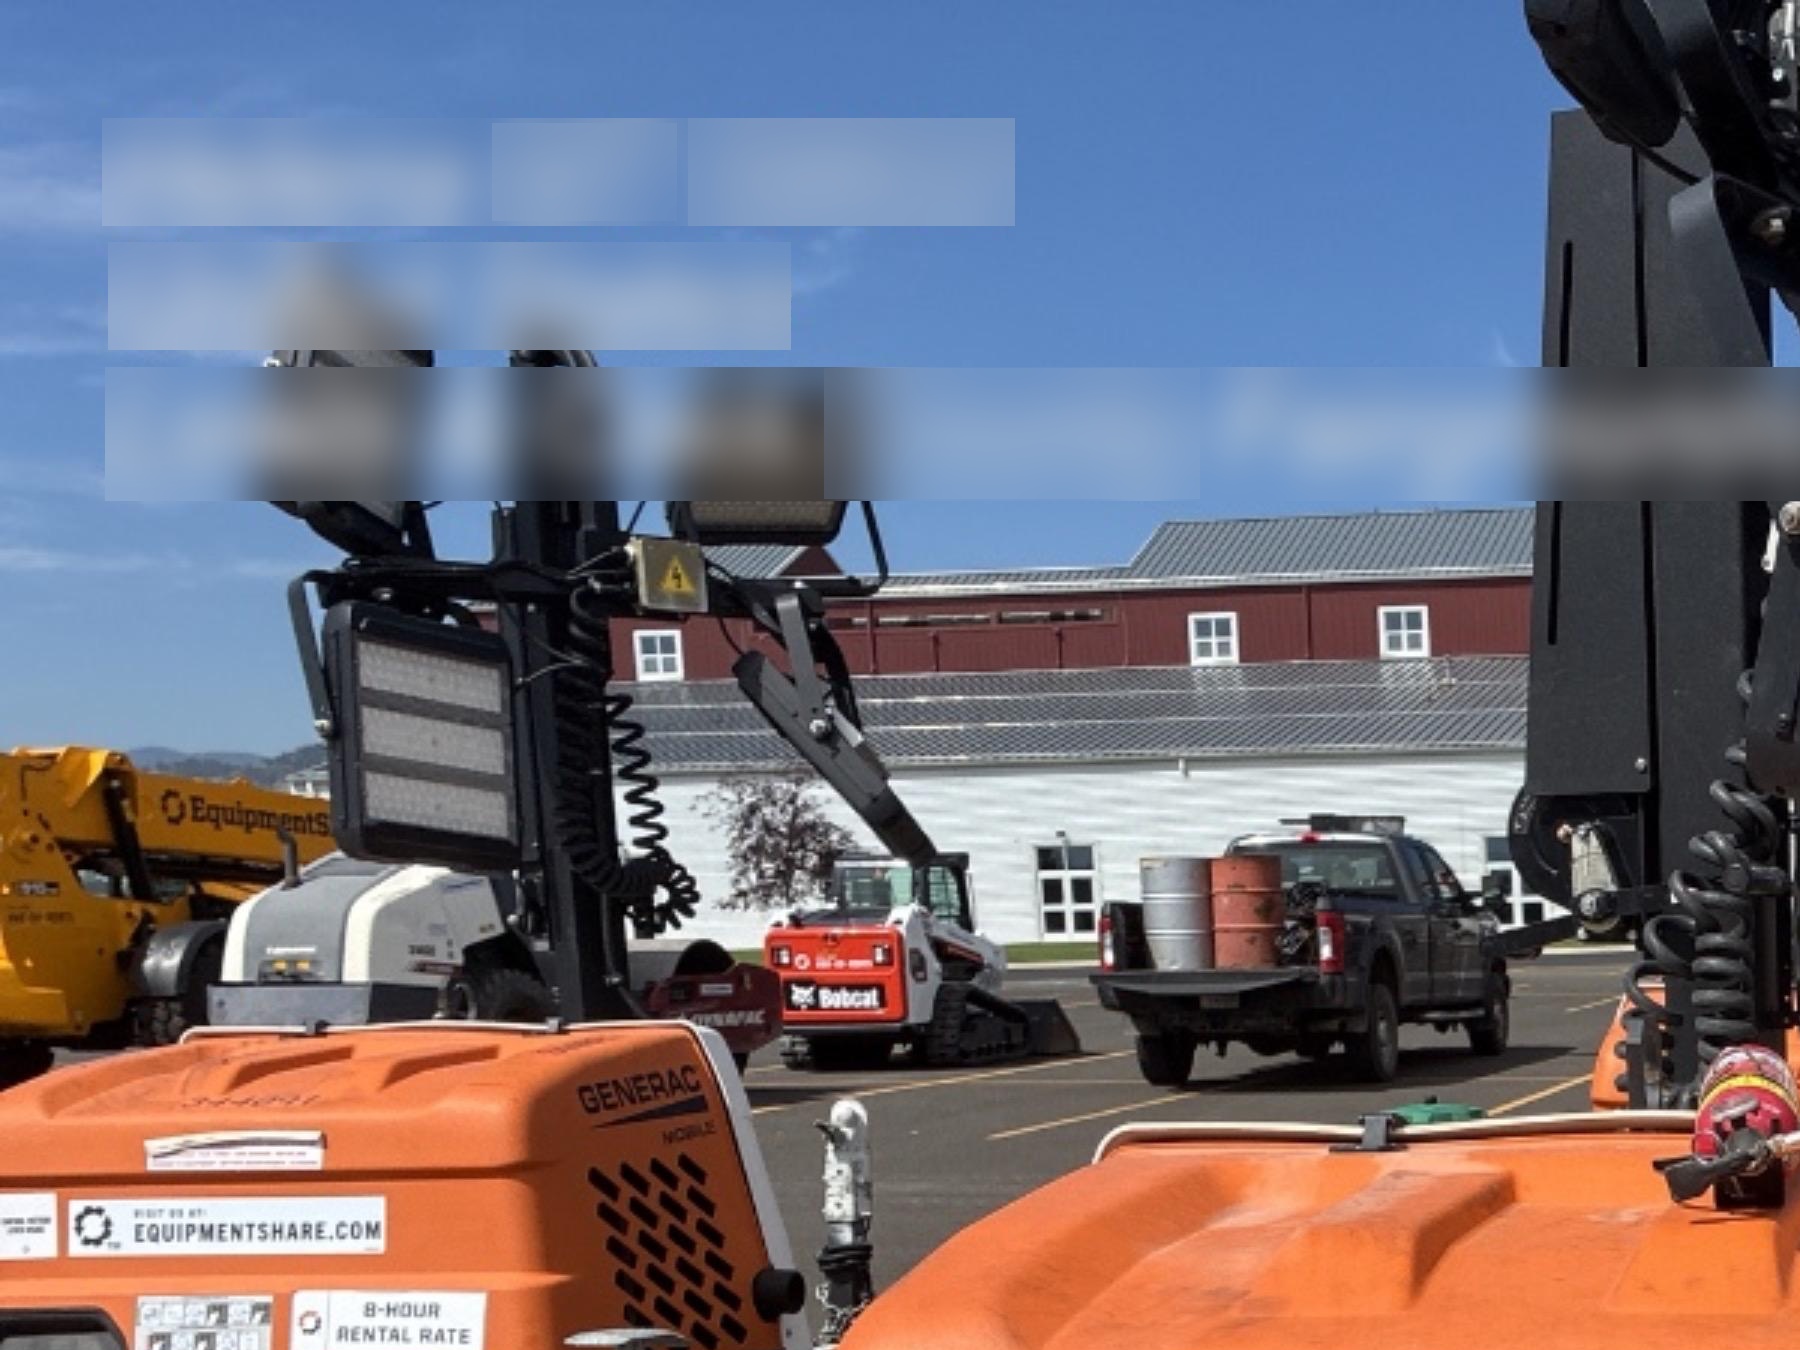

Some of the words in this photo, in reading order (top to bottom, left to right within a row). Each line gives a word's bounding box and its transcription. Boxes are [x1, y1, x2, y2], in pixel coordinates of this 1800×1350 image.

[818, 986, 880, 1008] Bobcat
[578, 1064, 700, 1114] GENERAC
[133, 1220, 382, 1244] EQUIPMENTSHARE.COM
[363, 1302, 442, 1319] 8-HOUR
[336, 1325, 412, 1343] RENTAL
[419, 1328, 472, 1345] RATE
